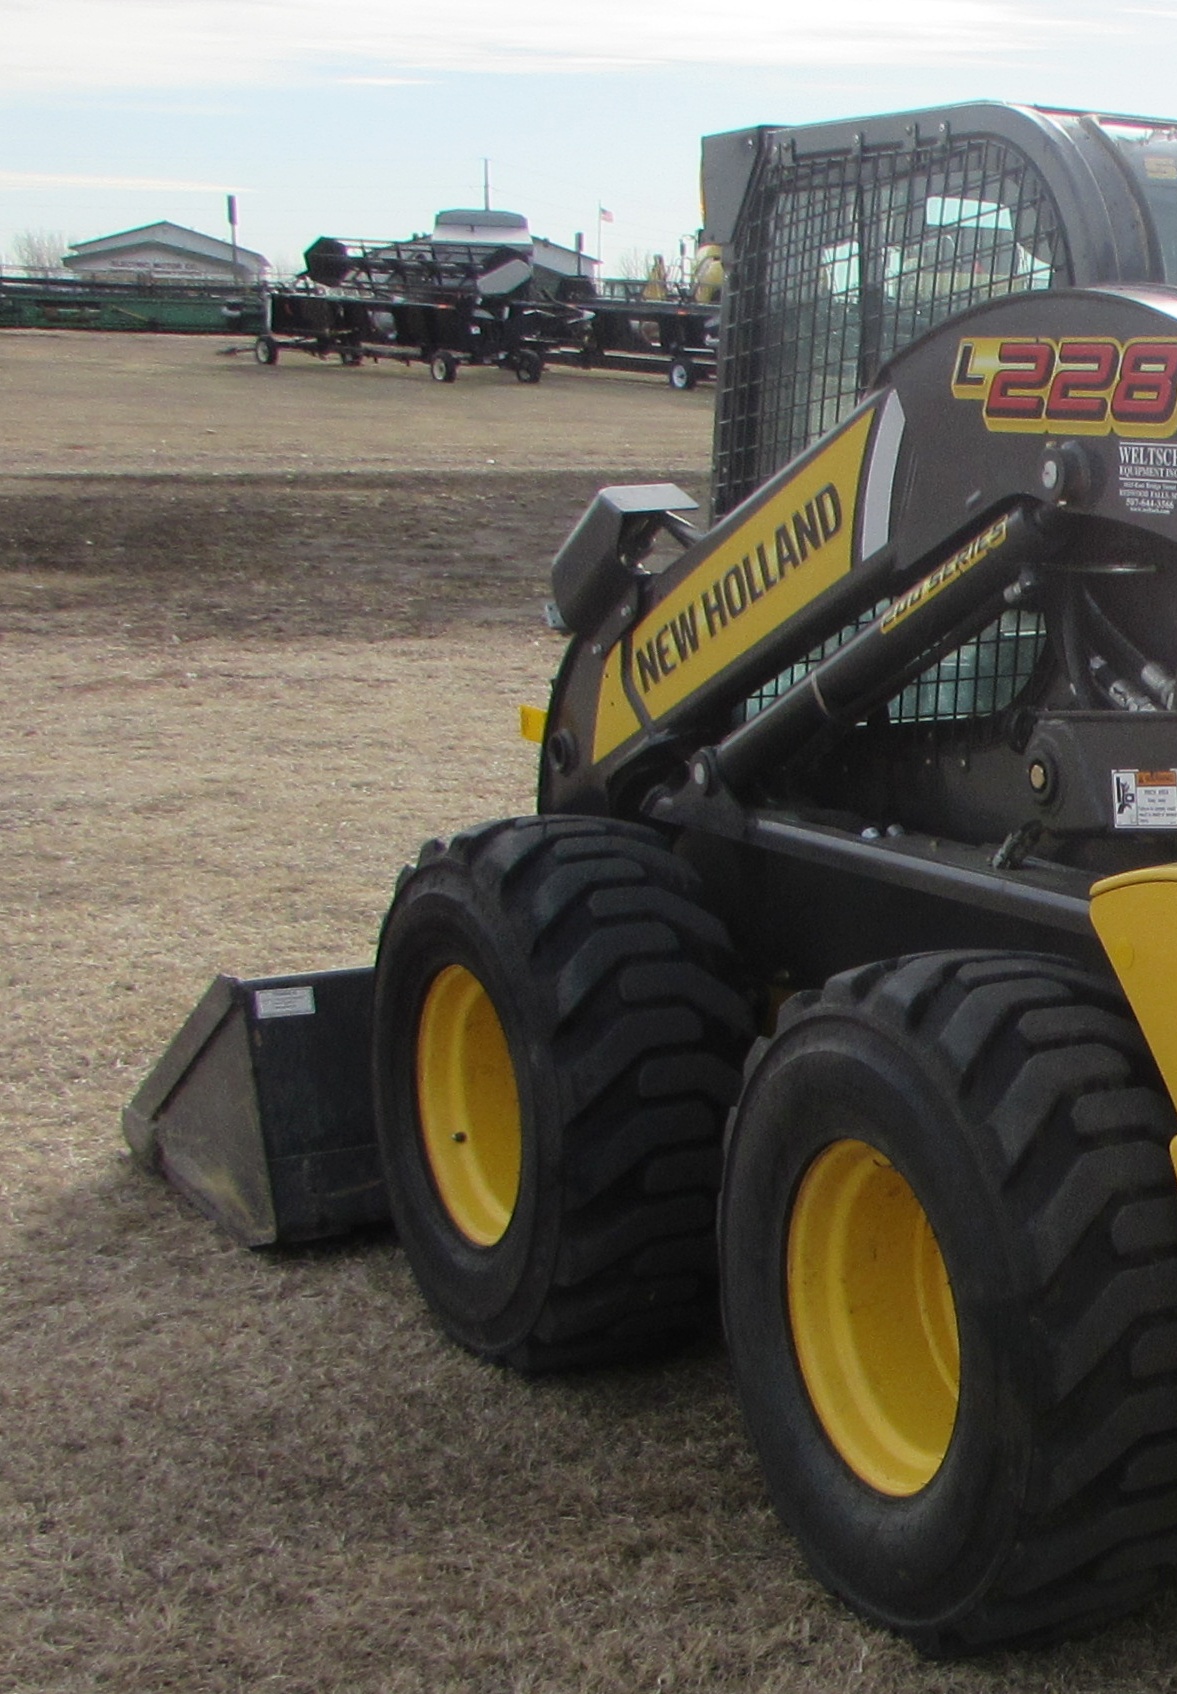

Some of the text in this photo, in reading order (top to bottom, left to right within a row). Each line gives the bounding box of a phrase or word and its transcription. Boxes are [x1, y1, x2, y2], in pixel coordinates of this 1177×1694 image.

[1119, 465, 1165, 478] EQUIPMENT
[636, 482, 842, 694] NEW HOLLAND
[922, 515, 1008, 596] SERIES
